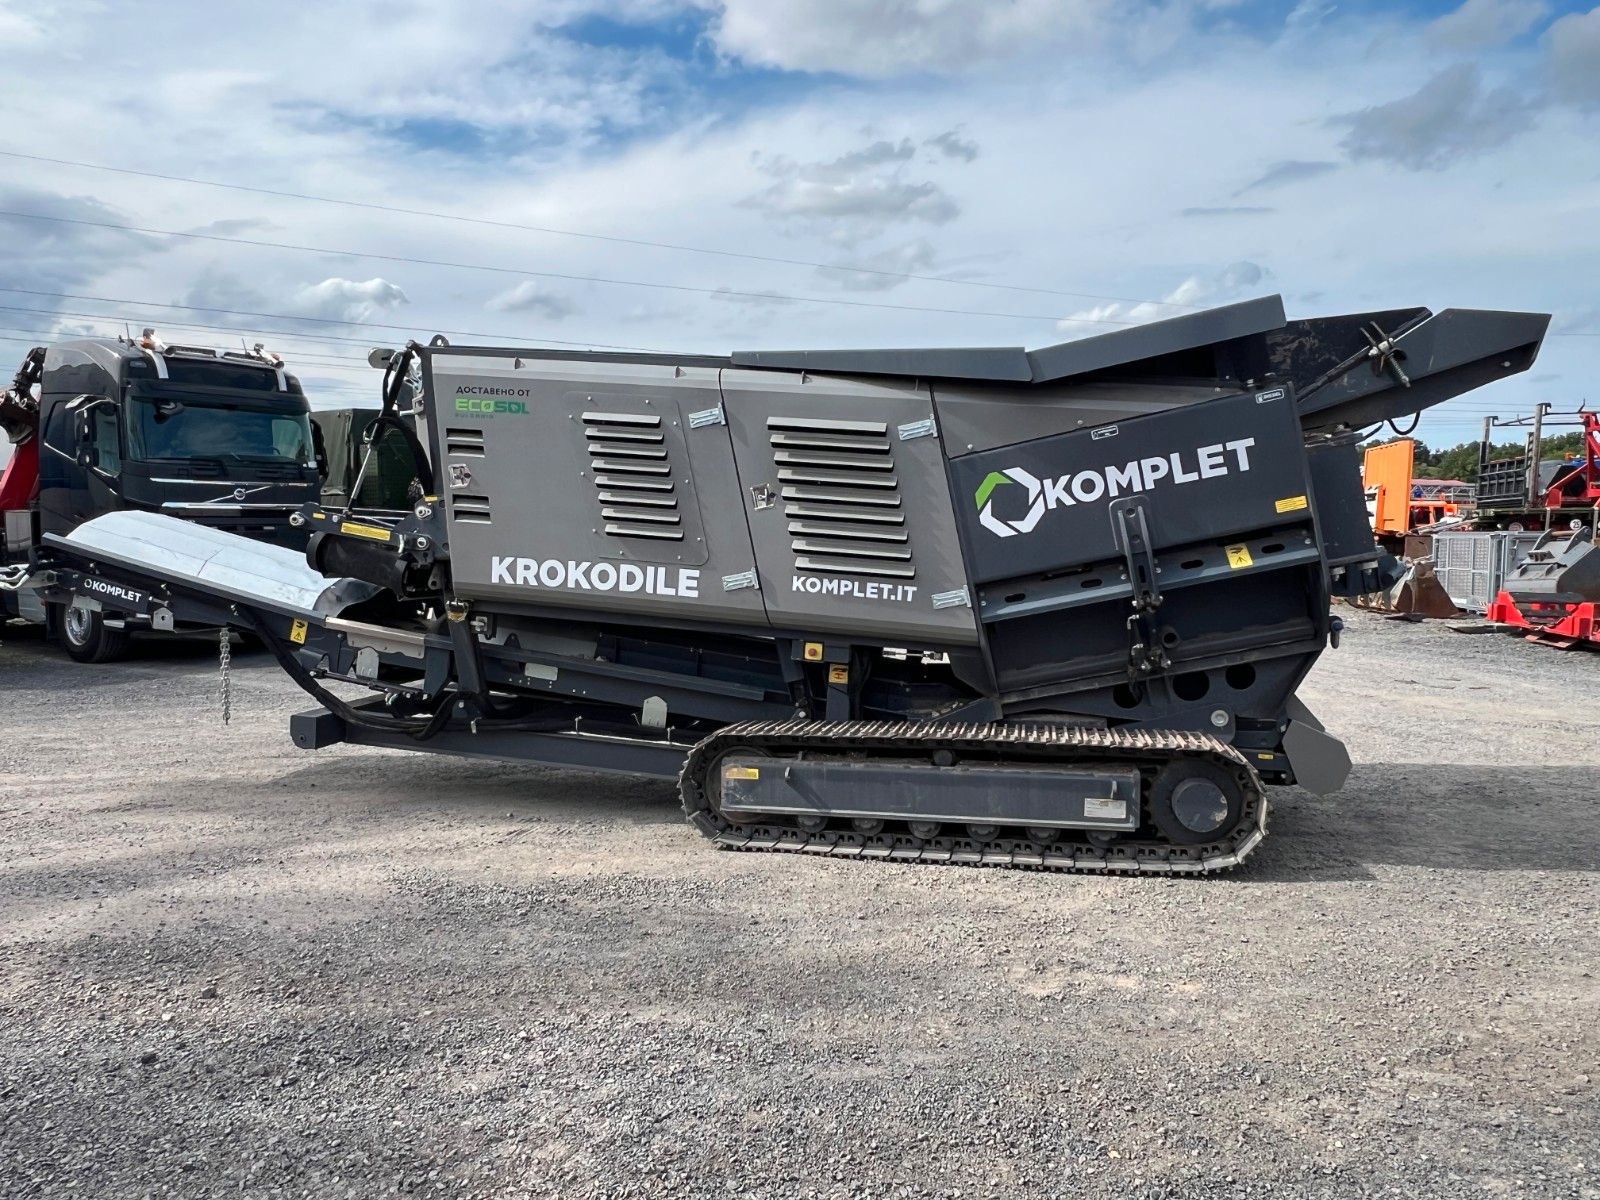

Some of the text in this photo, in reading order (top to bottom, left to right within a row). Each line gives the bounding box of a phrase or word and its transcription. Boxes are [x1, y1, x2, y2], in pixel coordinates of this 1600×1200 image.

[456, 386, 531, 397] ДОСТАВЕНО ОТ
[455, 399, 530, 415] ECOSOL
[1043, 437, 1255, 510] KOMPLET
[491, 556, 700, 598] KROKODILE
[792, 576, 918, 602] KOMPLET.IT
[92, 580, 142, 603] KOMPLET
